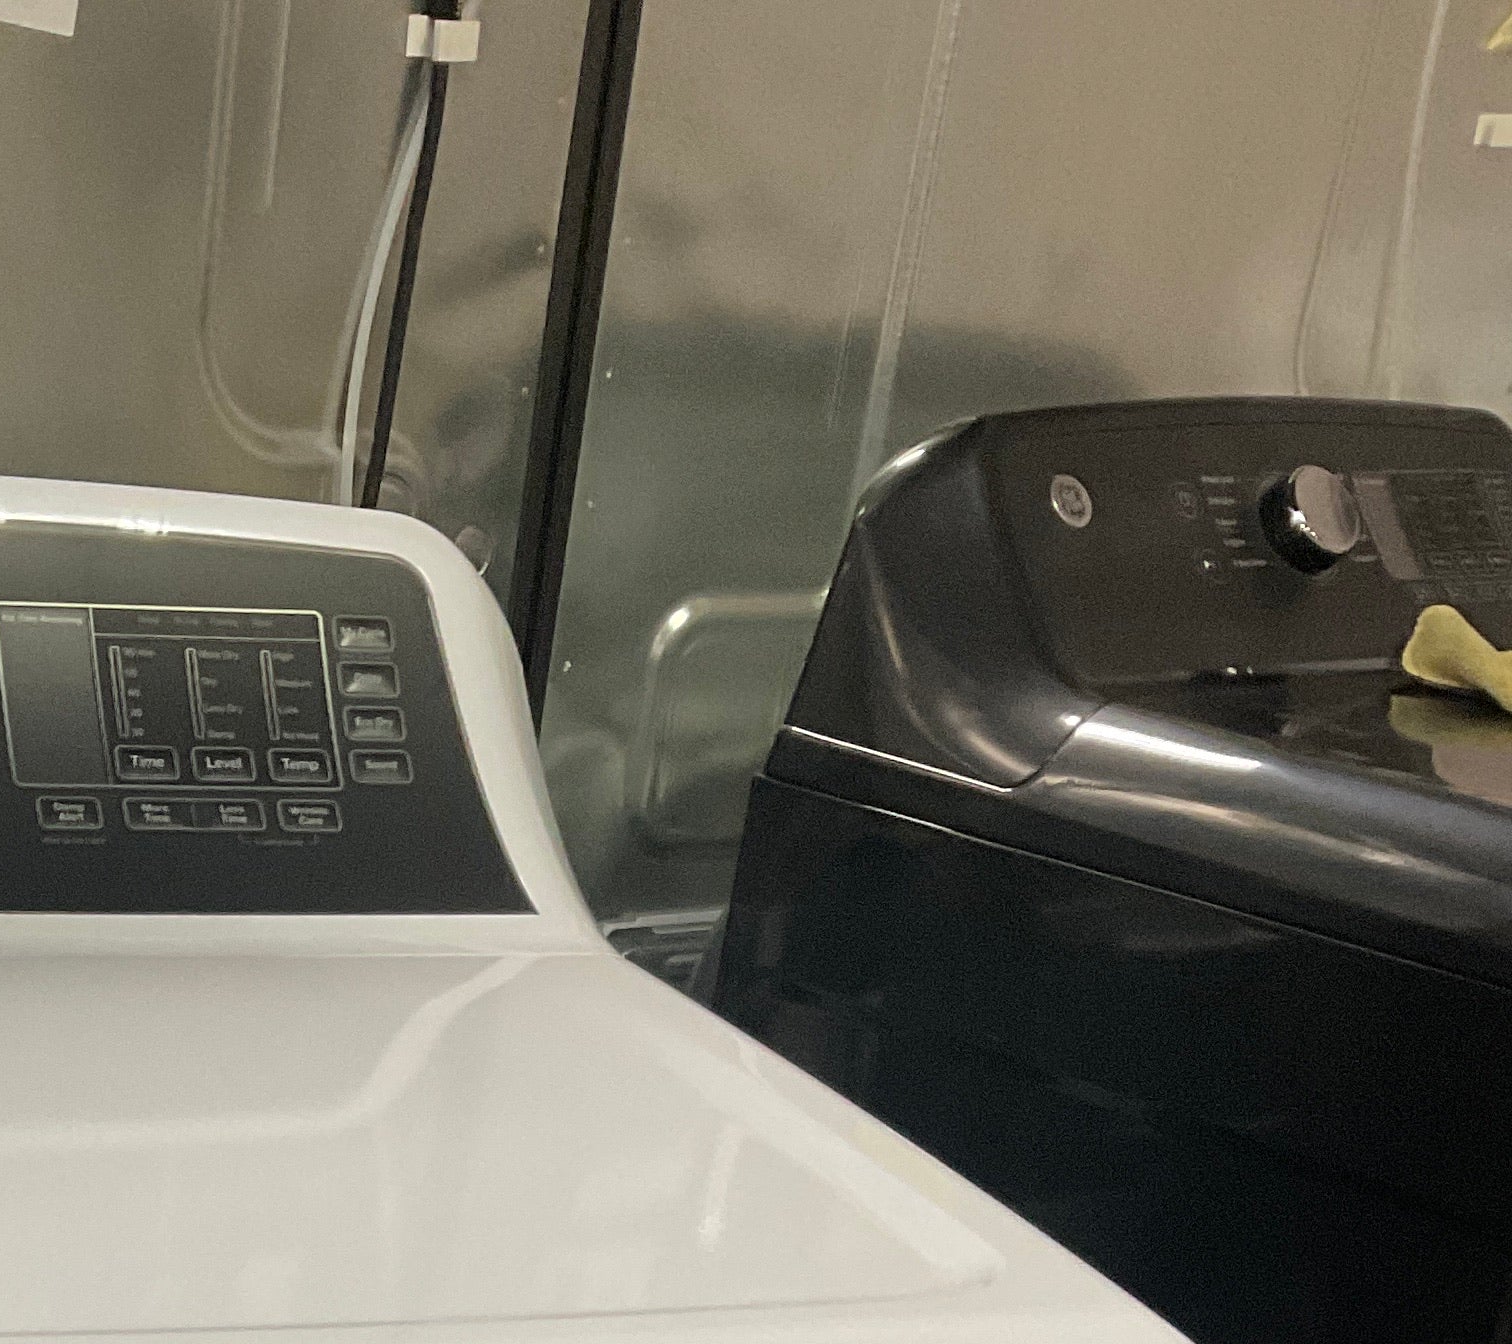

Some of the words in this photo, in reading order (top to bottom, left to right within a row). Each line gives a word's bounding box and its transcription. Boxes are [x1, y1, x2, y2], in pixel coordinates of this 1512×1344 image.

[130, 755, 165, 768] Time
[205, 756, 243, 769] Level
[281, 758, 319, 771] Temp
